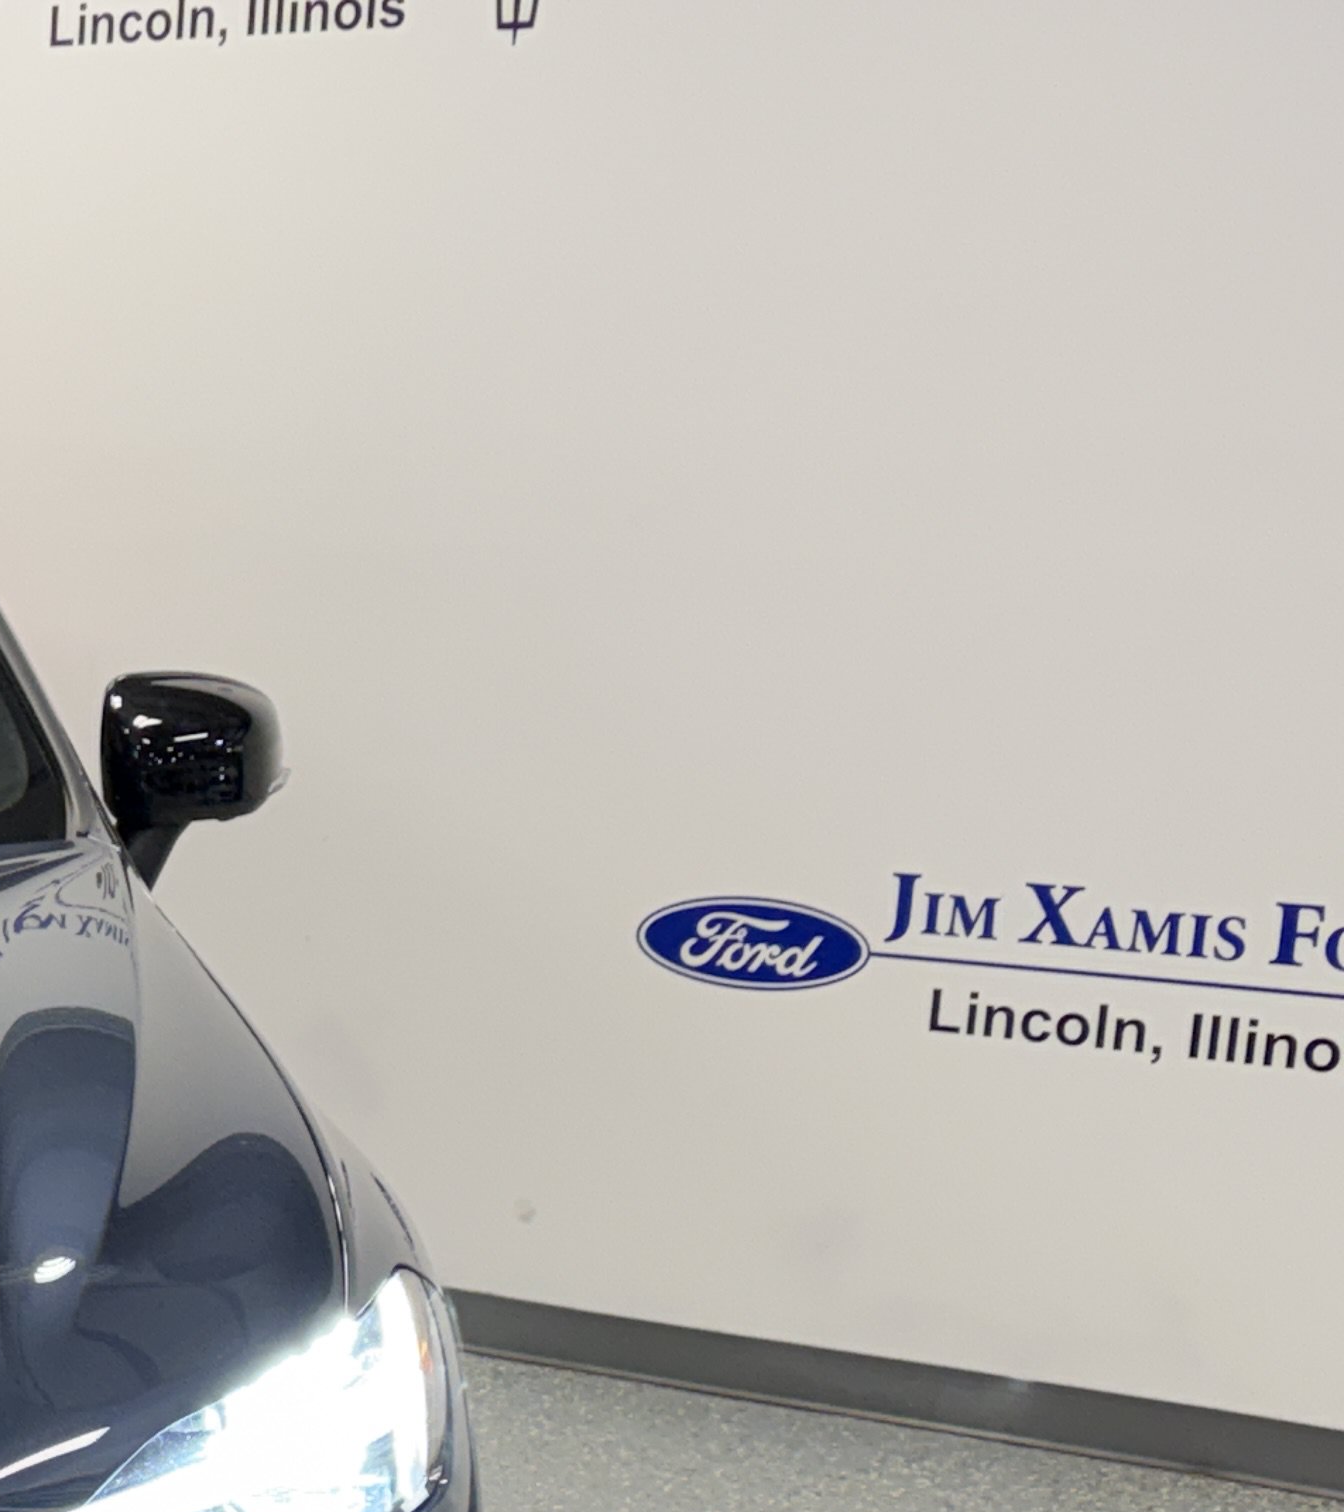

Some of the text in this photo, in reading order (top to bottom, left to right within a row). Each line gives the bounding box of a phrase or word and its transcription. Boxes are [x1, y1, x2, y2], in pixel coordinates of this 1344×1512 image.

[50, 0, 405, 46] Lincoln, Illinois
[679, 911, 824, 977] Ford
[884, 873, 1000, 942] JIM
[1018, 882, 1246, 961] XAMIS
[929, 988, 1162, 1063] Lincoln,
